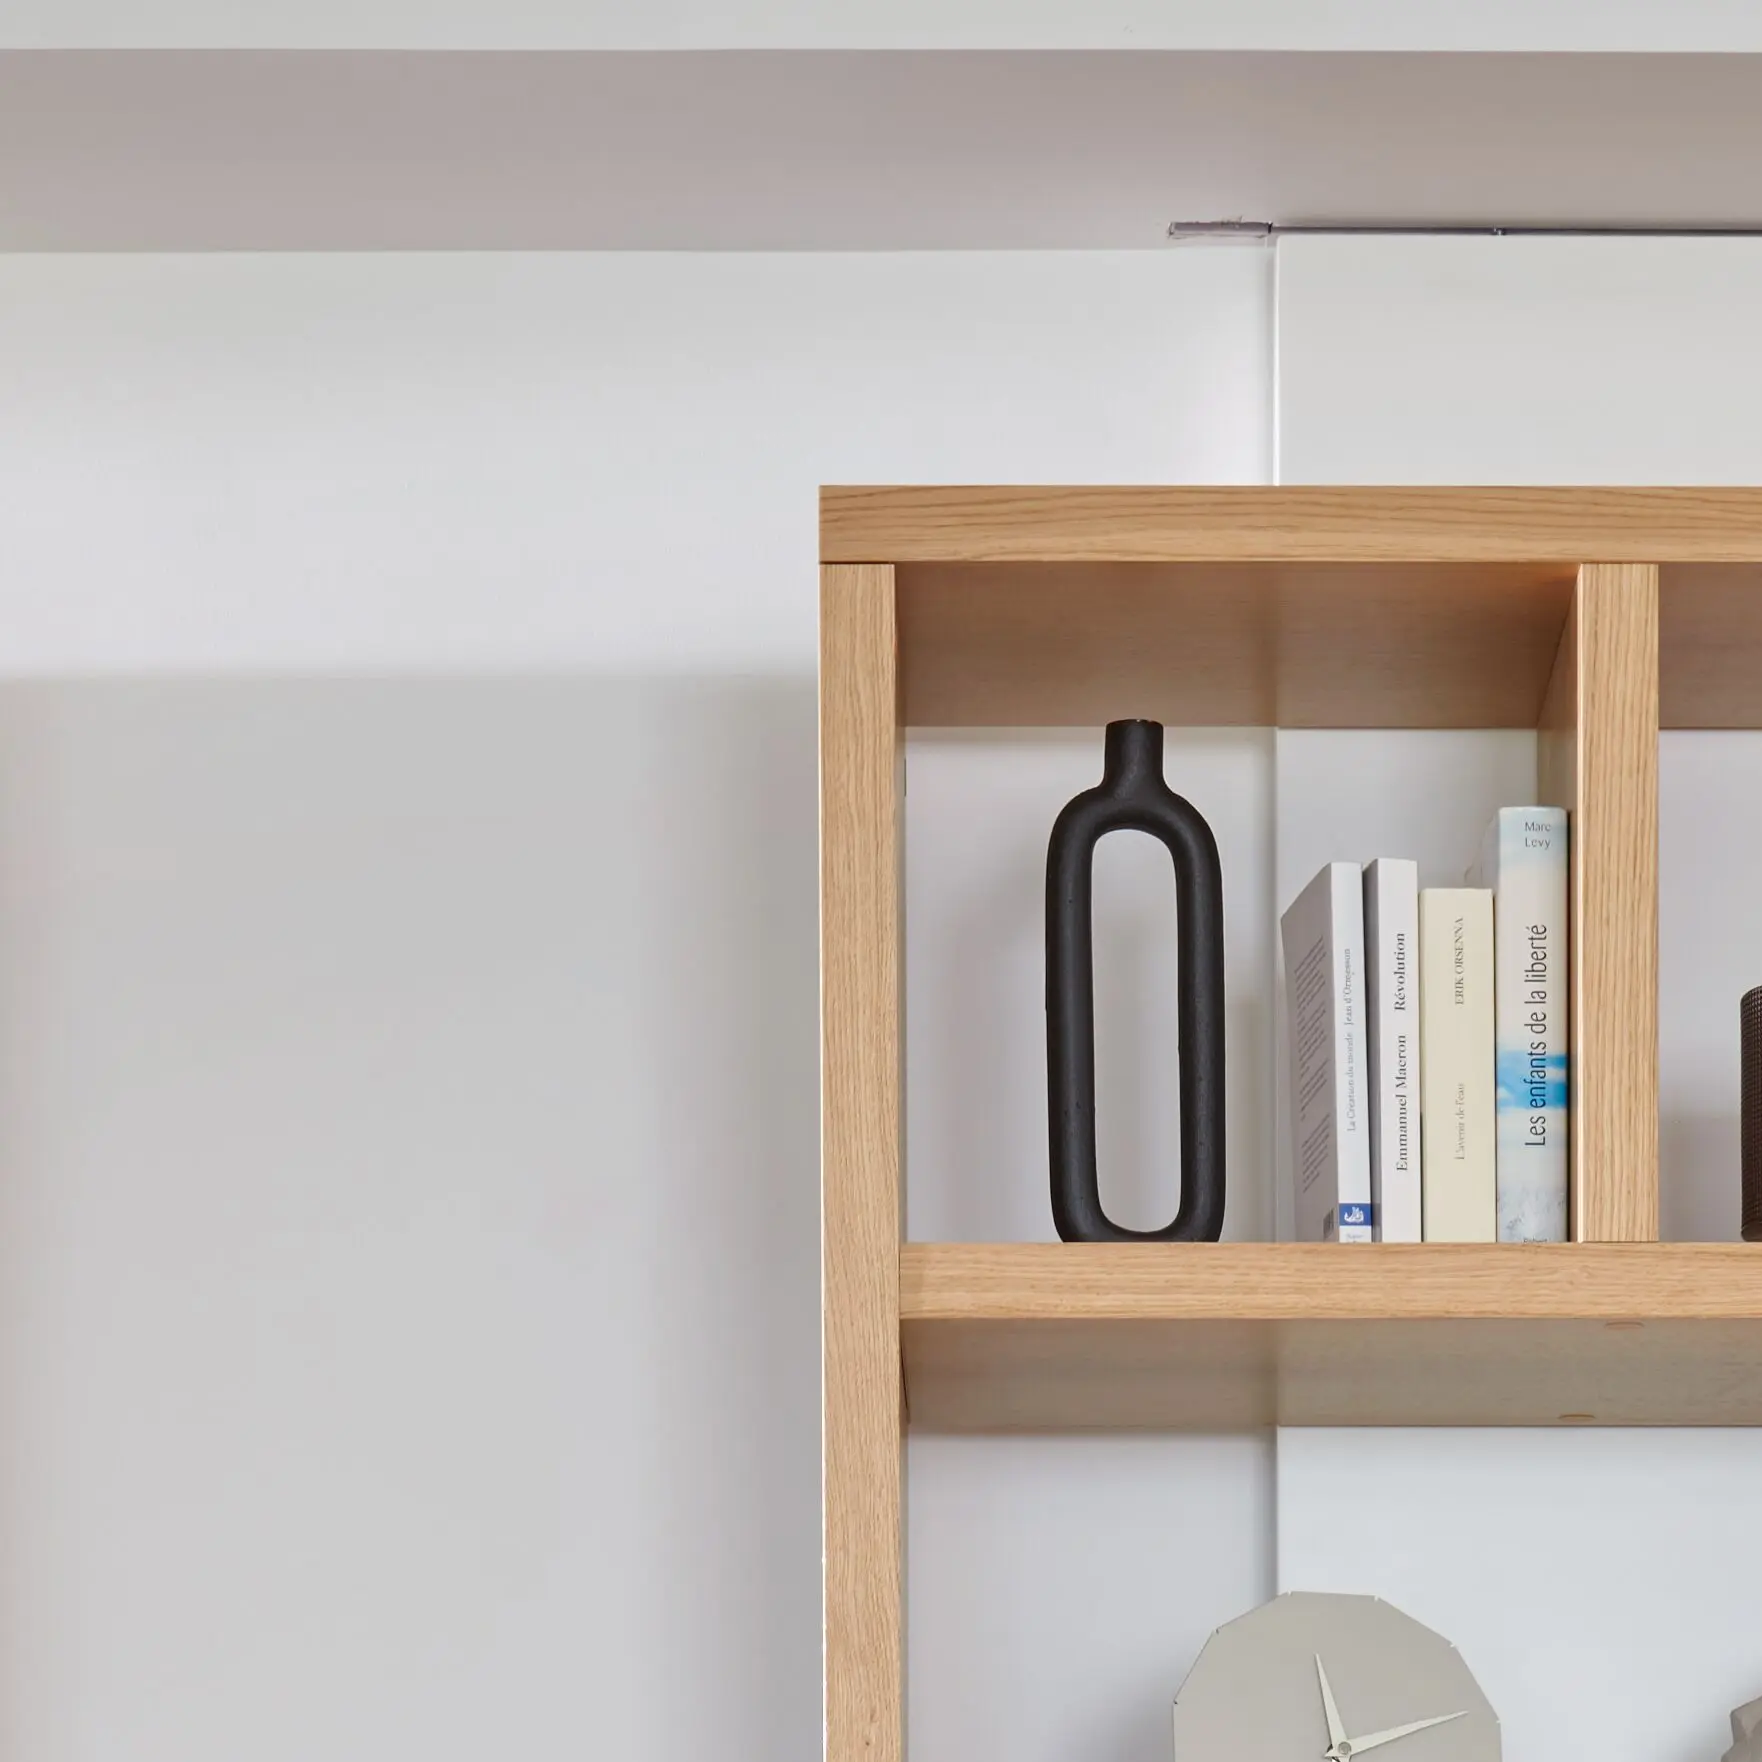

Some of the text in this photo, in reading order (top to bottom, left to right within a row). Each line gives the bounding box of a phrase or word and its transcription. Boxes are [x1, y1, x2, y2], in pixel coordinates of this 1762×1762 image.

[1525, 821, 1552, 831] Marc
[1525, 837, 1552, 851] Levy
[1453, 916, 1466, 1005] ERIK ORSENNA
[1393, 933, 1409, 1172] Emmanuel Macron Révolution
[1522, 924, 1547, 1147] Les enfants de la liberté
